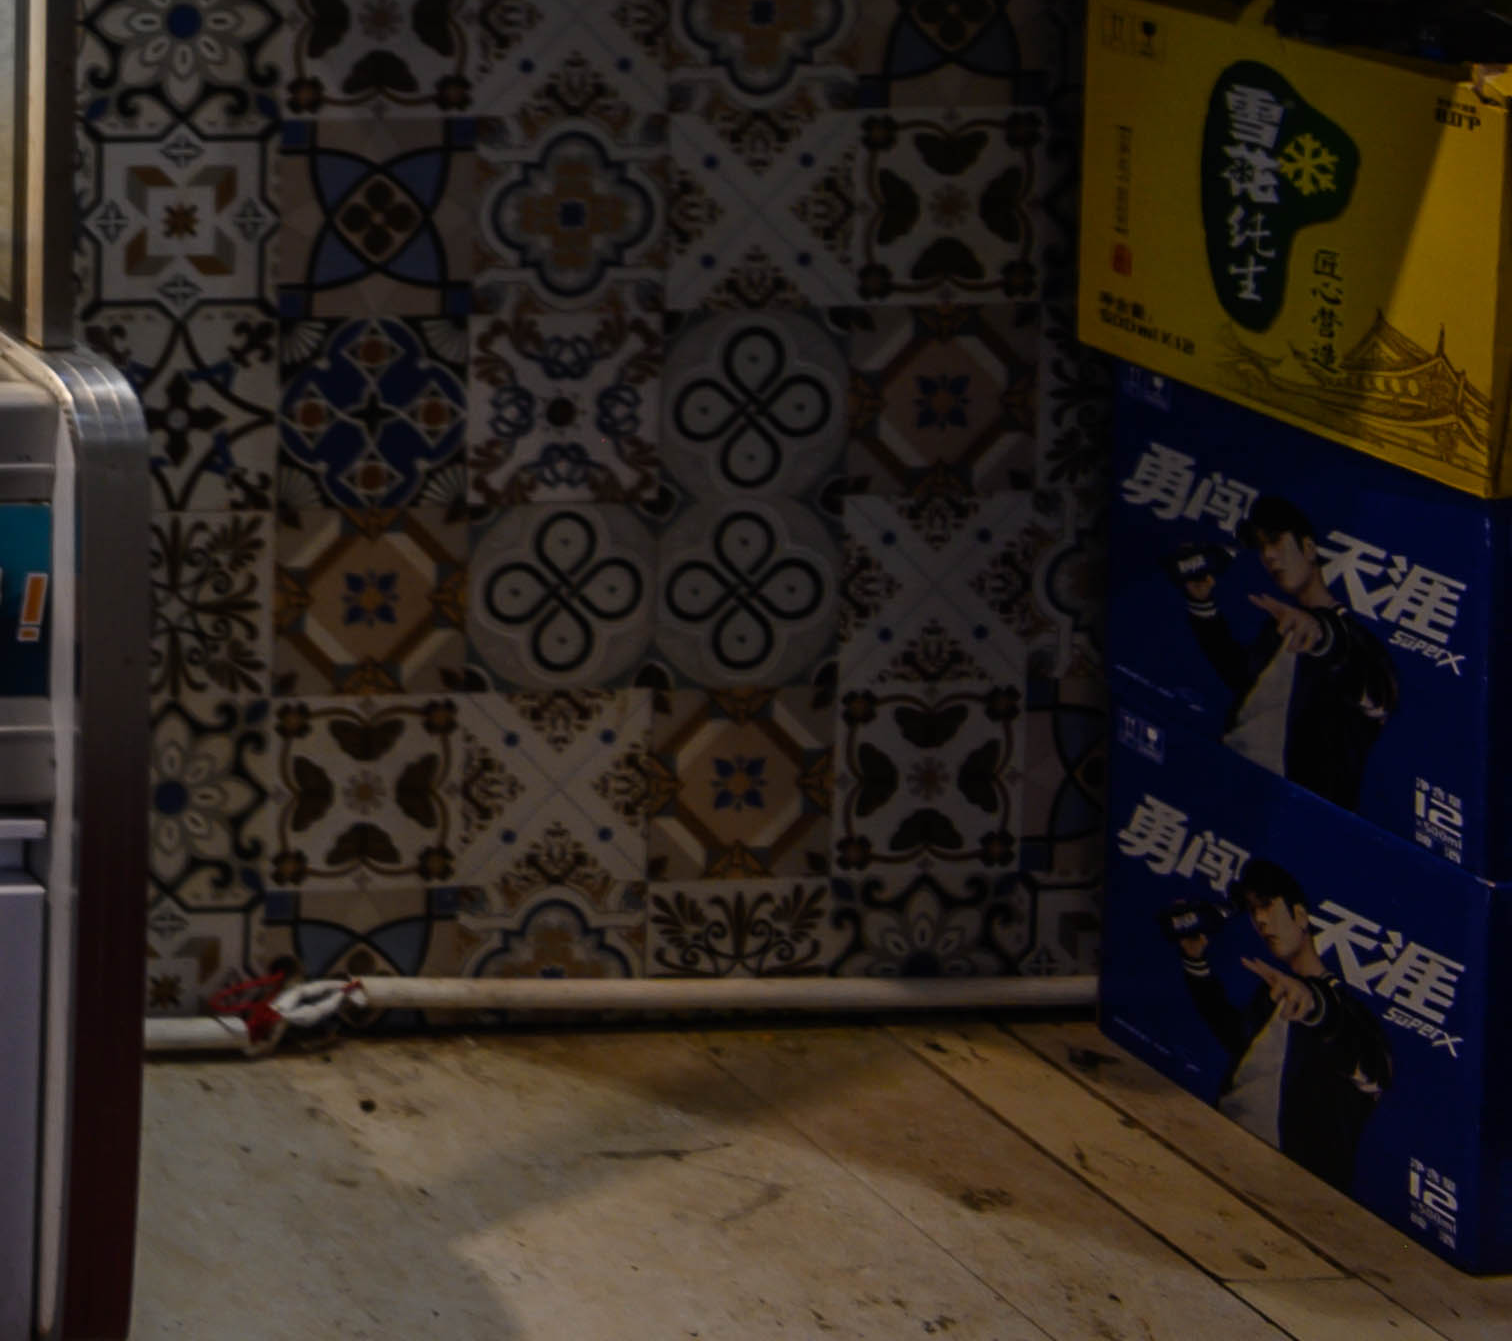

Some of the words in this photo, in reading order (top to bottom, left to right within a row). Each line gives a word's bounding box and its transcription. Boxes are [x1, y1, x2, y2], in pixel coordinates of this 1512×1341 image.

[1120, 439, 1262, 541] 勇闯
[1314, 528, 1470, 647] 天涯
[1413, 789, 1465, 838] 12
[1113, 792, 1254, 901] 勇闯
[1306, 897, 1468, 1025] 天涯
[1408, 1169, 1460, 1222] 12
